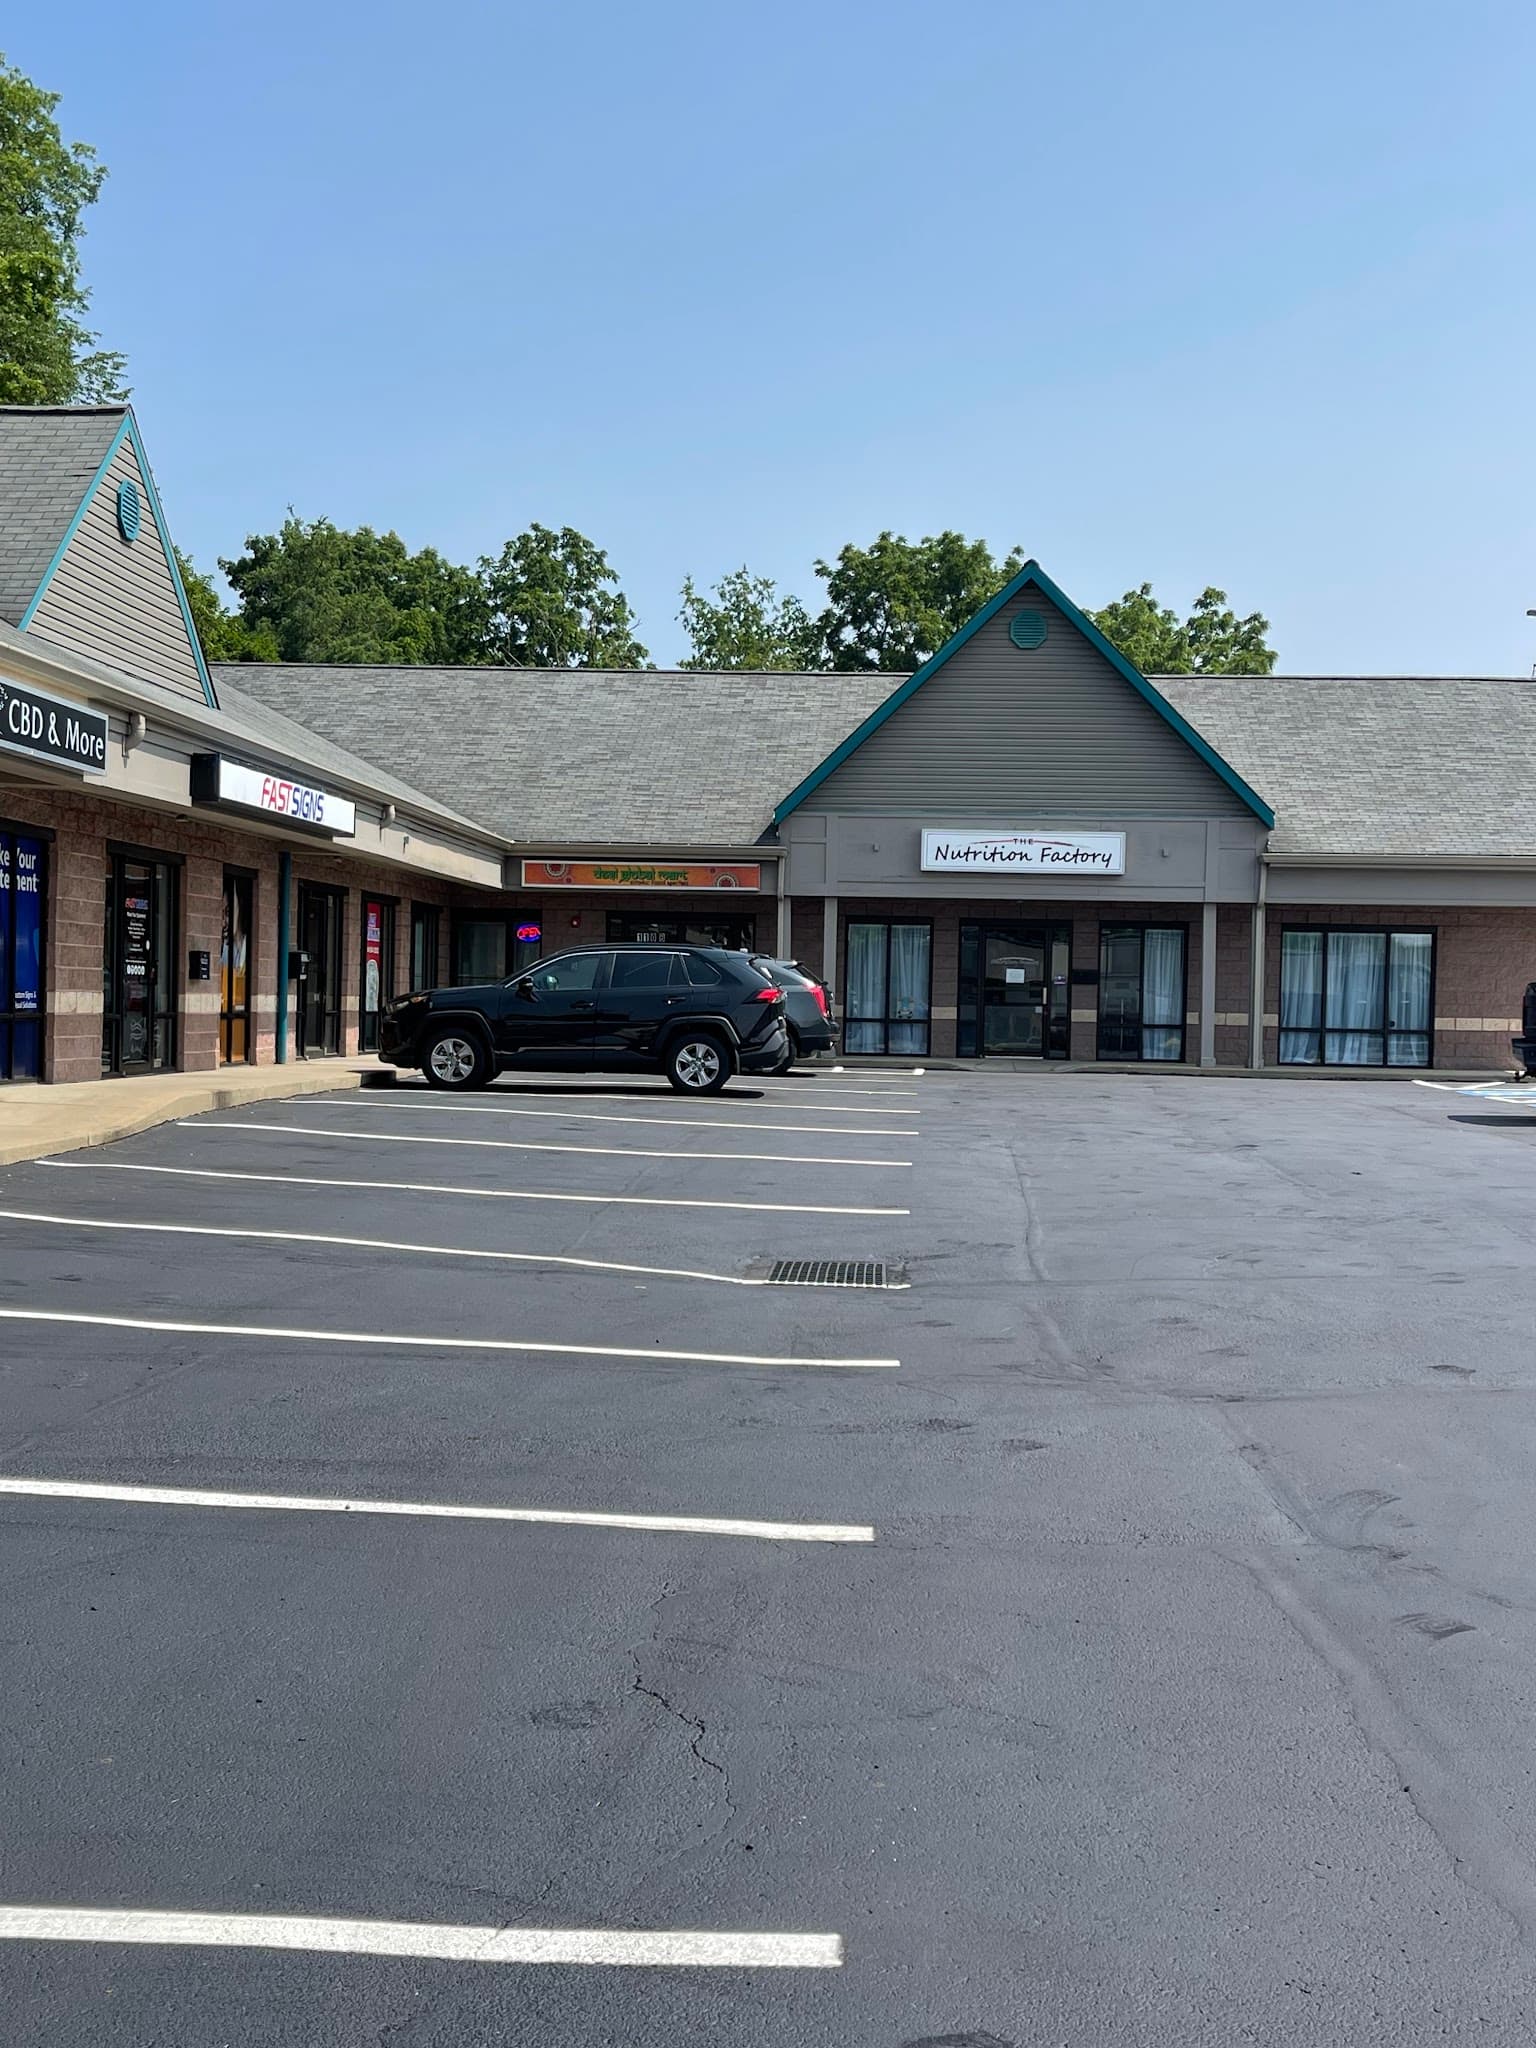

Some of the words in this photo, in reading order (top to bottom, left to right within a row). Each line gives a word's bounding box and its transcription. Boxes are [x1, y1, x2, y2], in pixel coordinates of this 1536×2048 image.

[8, 698, 44, 739] CBD
[47, 711, 61, 746] &
[64, 717, 104, 760] More
[260, 776, 325, 822] FASTSIGNS
[934, 844, 1032, 863] Nutrition
[1040, 846, 1112, 868] Factory
[1012, 837, 1034, 846] THE
